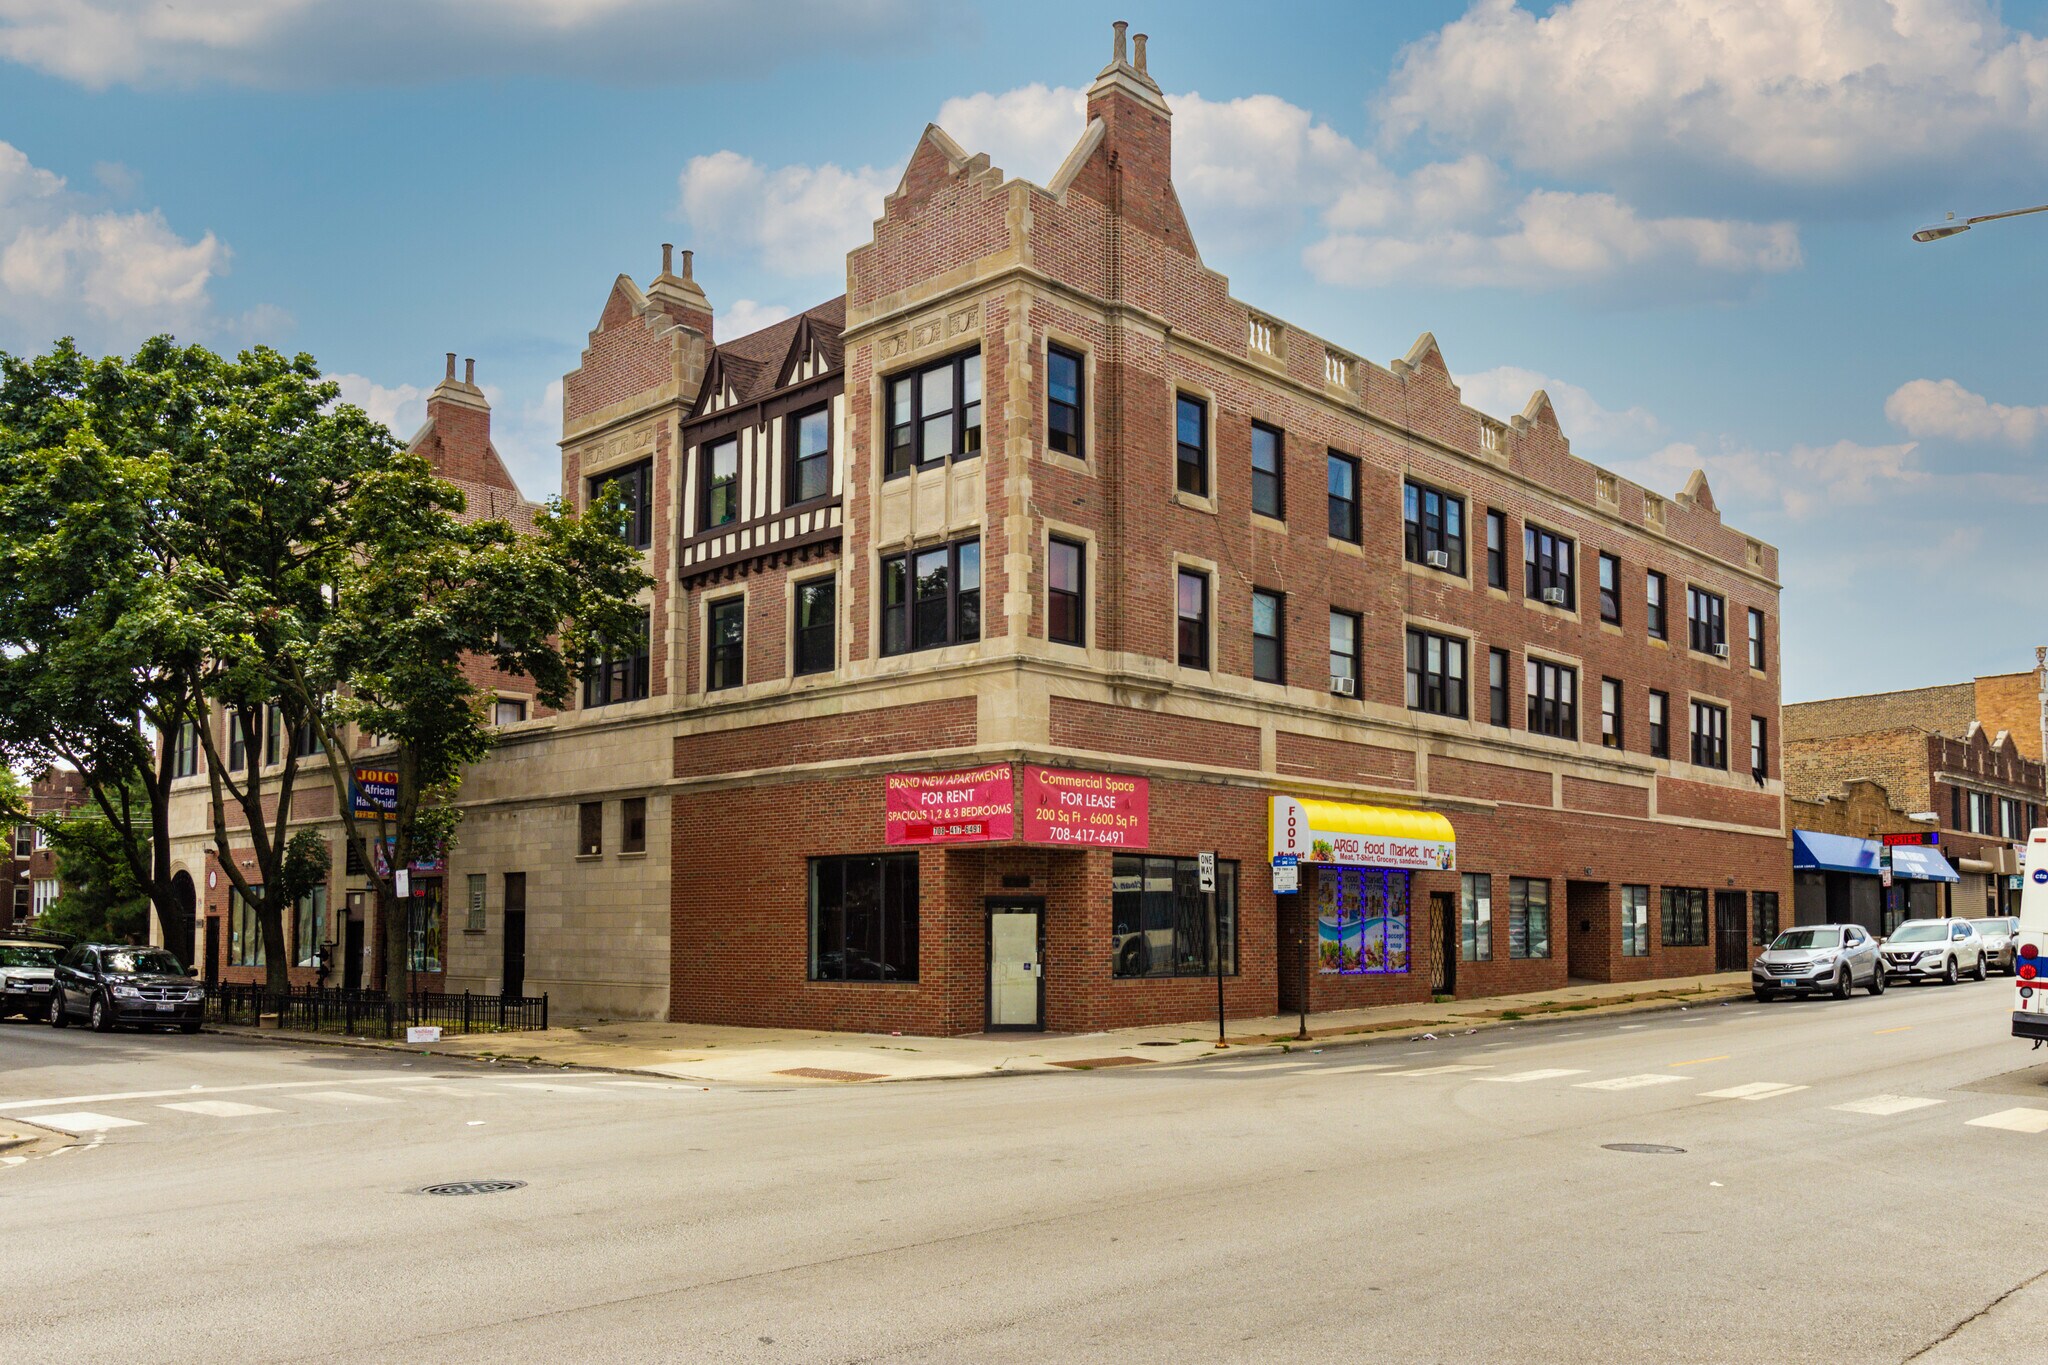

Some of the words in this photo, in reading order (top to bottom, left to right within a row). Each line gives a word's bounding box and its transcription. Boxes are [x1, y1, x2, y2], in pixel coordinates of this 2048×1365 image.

[889, 777, 920, 789] BRAND
[922, 775, 946, 787] NEW
[946, 768, 1010, 785] APARTMENTS
[1040, 770, 1102, 789] Commercial
[1106, 777, 1134, 793] Space
[365, 784, 394, 796] African
[921, 792, 943, 805] FOR
[946, 789, 974, 803] RENT
[1060, 792, 1083, 806] FOR
[1086, 794, 1116, 808] LEASE
[888, 810, 927, 822] SPACIOUS
[930, 809, 942, 820] 1,2
[944, 809, 951, 818] &
[953, 808, 959, 818] 3
[961, 804, 1012, 817] BEDROOMS
[1036, 808, 1055, 820] 200
[1058, 810, 1069, 825] Sq
[1072, 811, 1080, 822] Ft
[1090, 812, 1113, 825] 6600
[1116, 814, 1127, 828] Sq
[1130, 816, 1138, 826] Ft
[1050, 827, 1124, 844] 708-417-6491
[1288, 806, 1296, 848] FOOD
[1334, 838, 1358, 853] ARGO
[1364, 841, 1384, 855] food
[1201, 855, 1212, 864] ONE
[1340, 853, 1354, 861] Meat,
[1201, 866, 1213, 875] WAY
